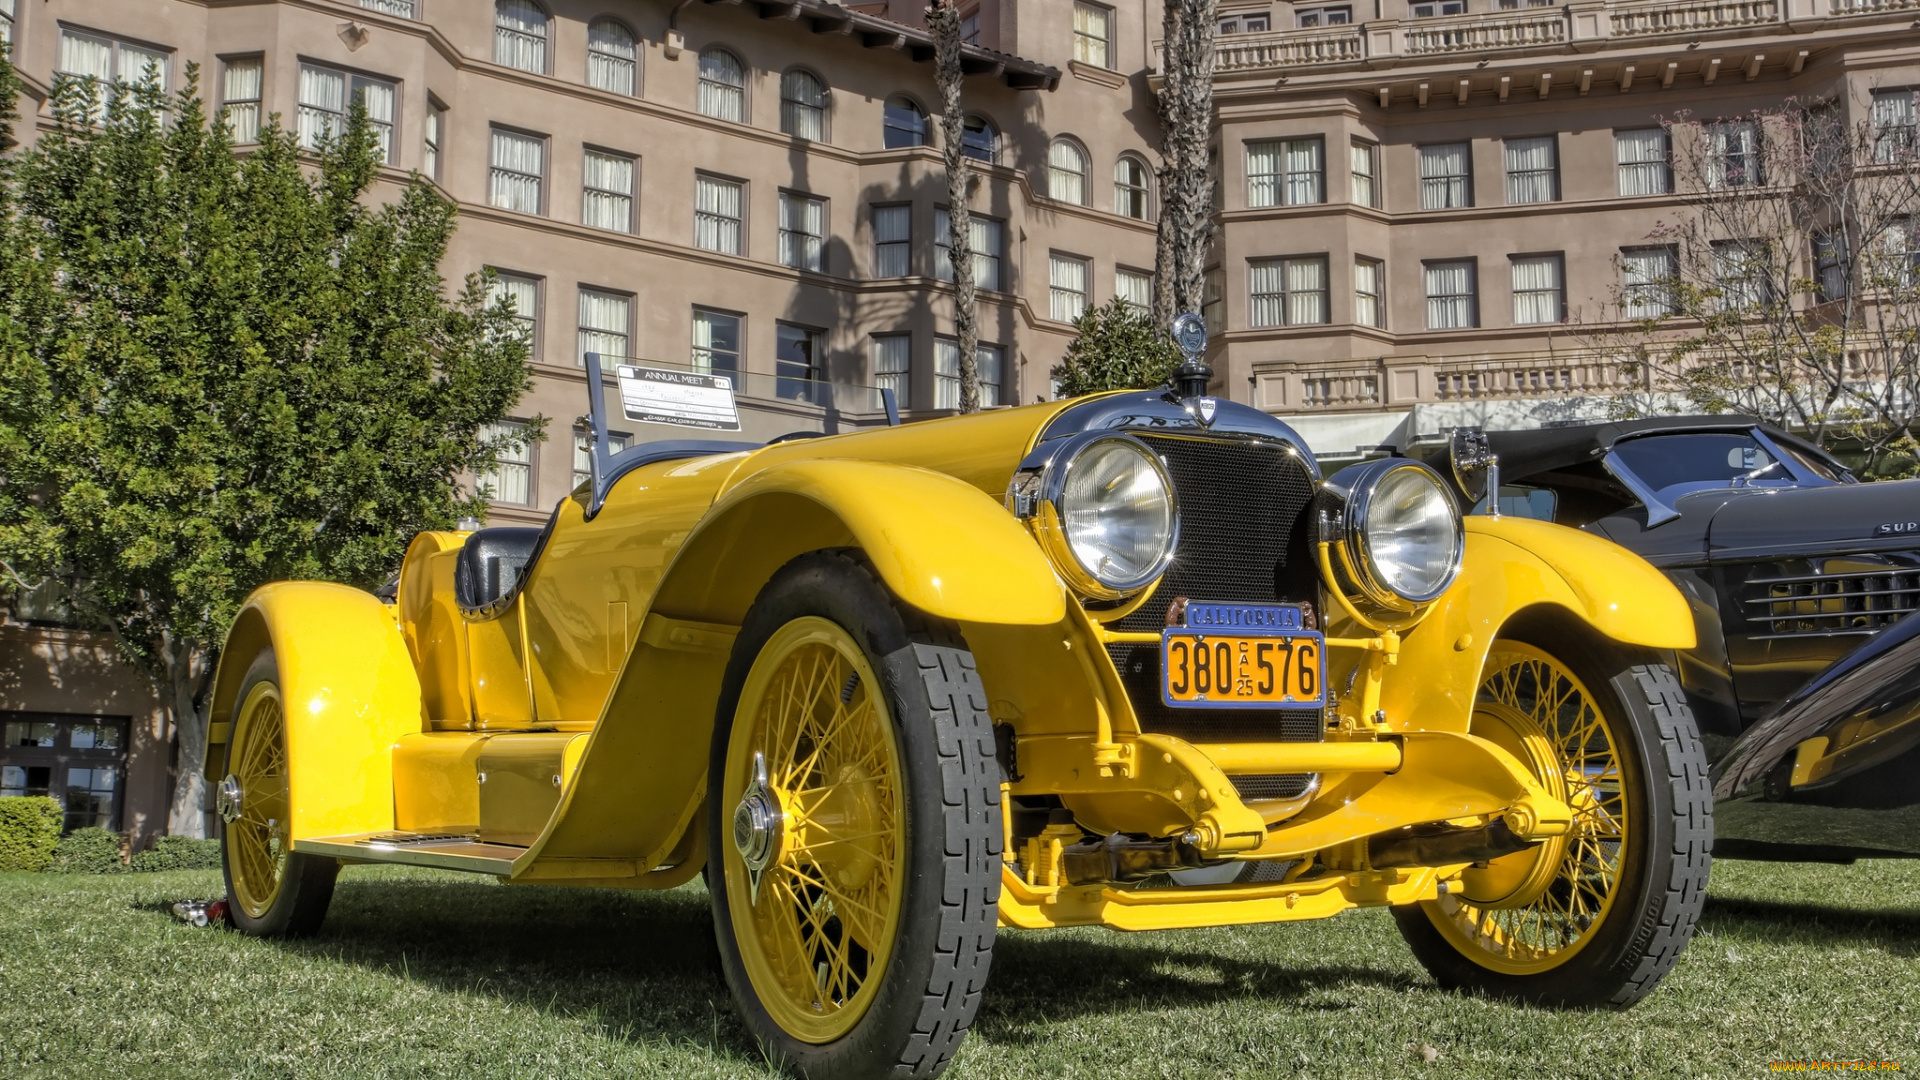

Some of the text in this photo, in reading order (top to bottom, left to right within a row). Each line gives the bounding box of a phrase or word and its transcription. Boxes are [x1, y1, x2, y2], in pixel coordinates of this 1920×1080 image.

[645, 372, 680, 383] ANNUAL
[681, 376, 704, 385] MEET
[1193, 607, 1295, 627] CALIFORNIA
[1171, 641, 1233, 695] 380
[1256, 642, 1315, 696] 576
[1236, 679, 1253, 696] 25
[1621, 896, 1662, 970] GOODRICH
